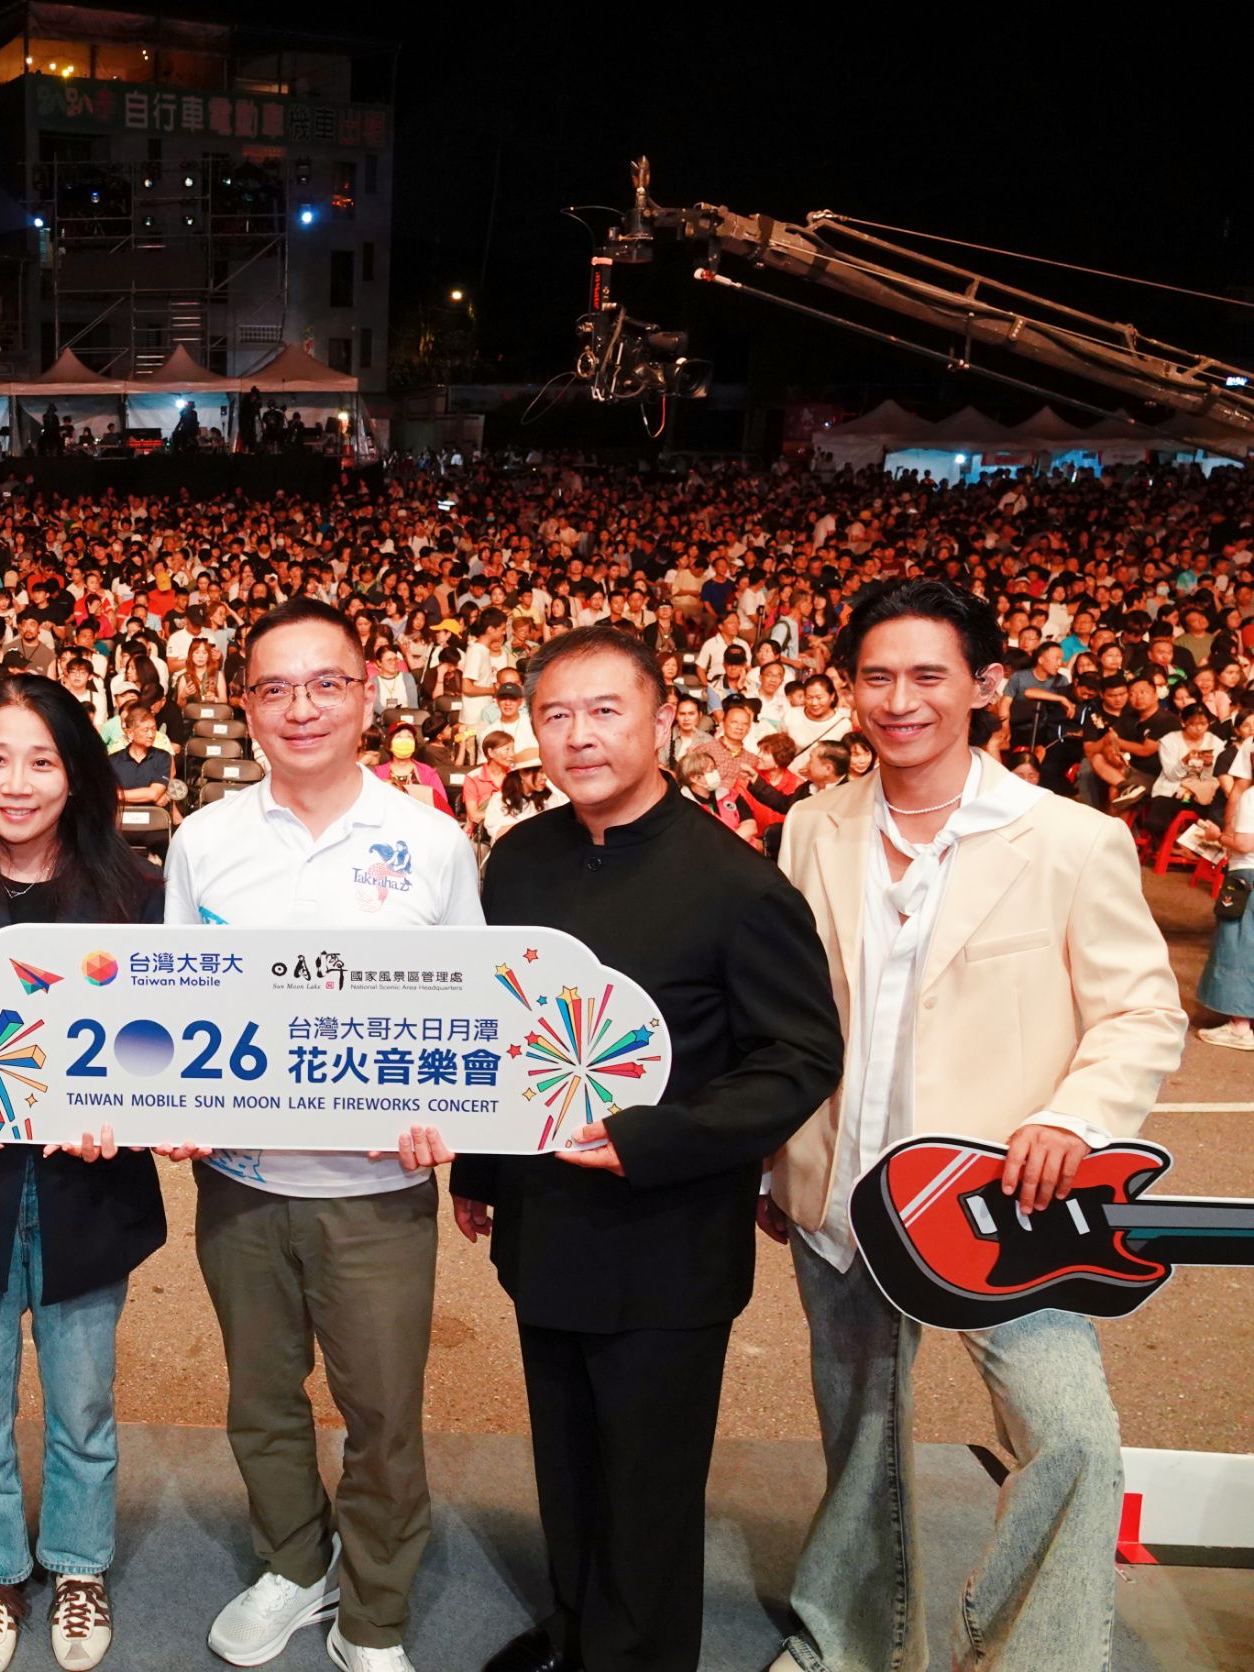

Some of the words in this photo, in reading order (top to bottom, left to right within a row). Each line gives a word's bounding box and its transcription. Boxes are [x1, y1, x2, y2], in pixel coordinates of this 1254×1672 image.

[130, 952, 244, 974] 台灣大哥大
[131, 975, 176, 987] Taiwan
[179, 976, 221, 987] Mobile
[350, 971, 463, 983] 國家風景區管理處
[288, 1016, 499, 1042] 台灣大哥大日月潭
[66, 1018, 268, 1081] 2026
[288, 1046, 502, 1086] 花火音樂會
[66, 1093, 123, 1107] TAIWAN
[131, 1094, 187, 1108] MOBILE
[195, 1095, 225, 1108] SUN
[233, 1096, 280, 1109] MOON
[288, 1096, 326, 1110] LAKE
[333, 1097, 420, 1111] FIREWORKS
[428, 1098, 499, 1113] CONCERT
